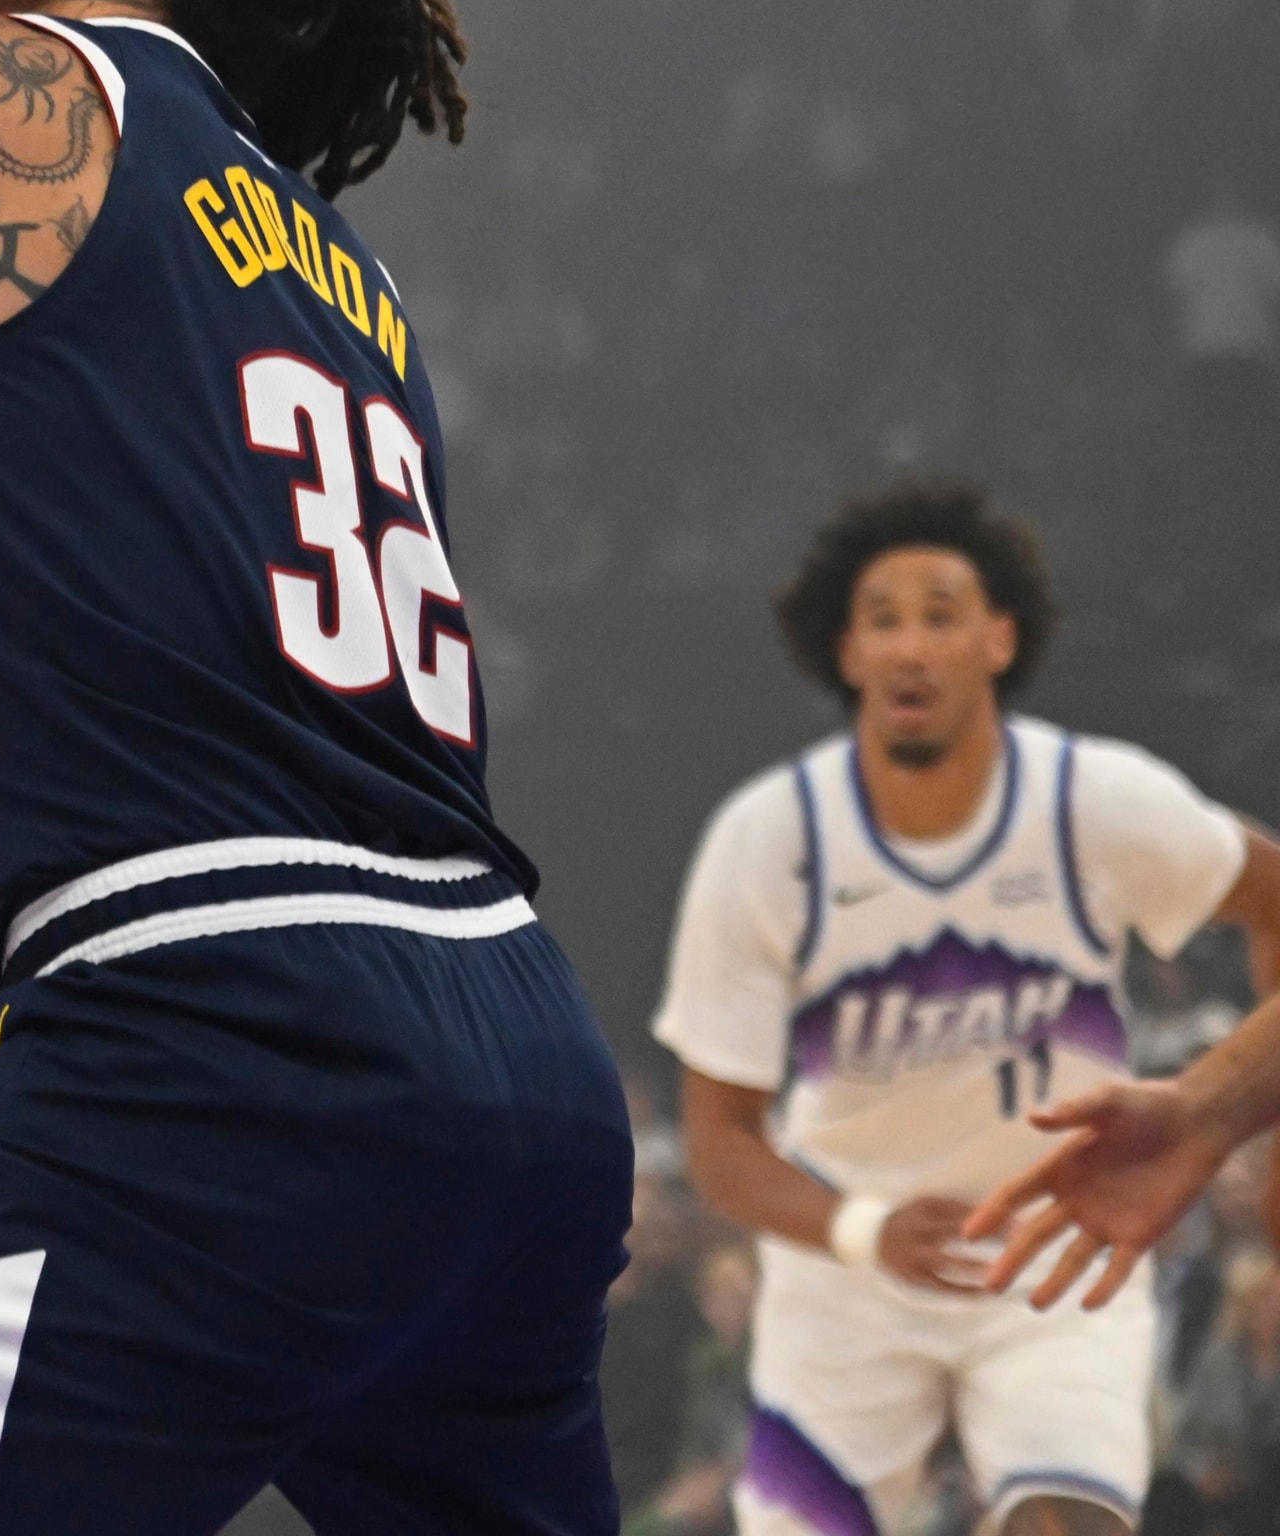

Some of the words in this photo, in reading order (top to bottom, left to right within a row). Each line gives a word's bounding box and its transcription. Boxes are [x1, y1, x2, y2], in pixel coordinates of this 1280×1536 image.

[183, 165, 407, 384] GORDON
[236, 349, 477, 750] 32
[833, 976, 1074, 1085] UTAH
